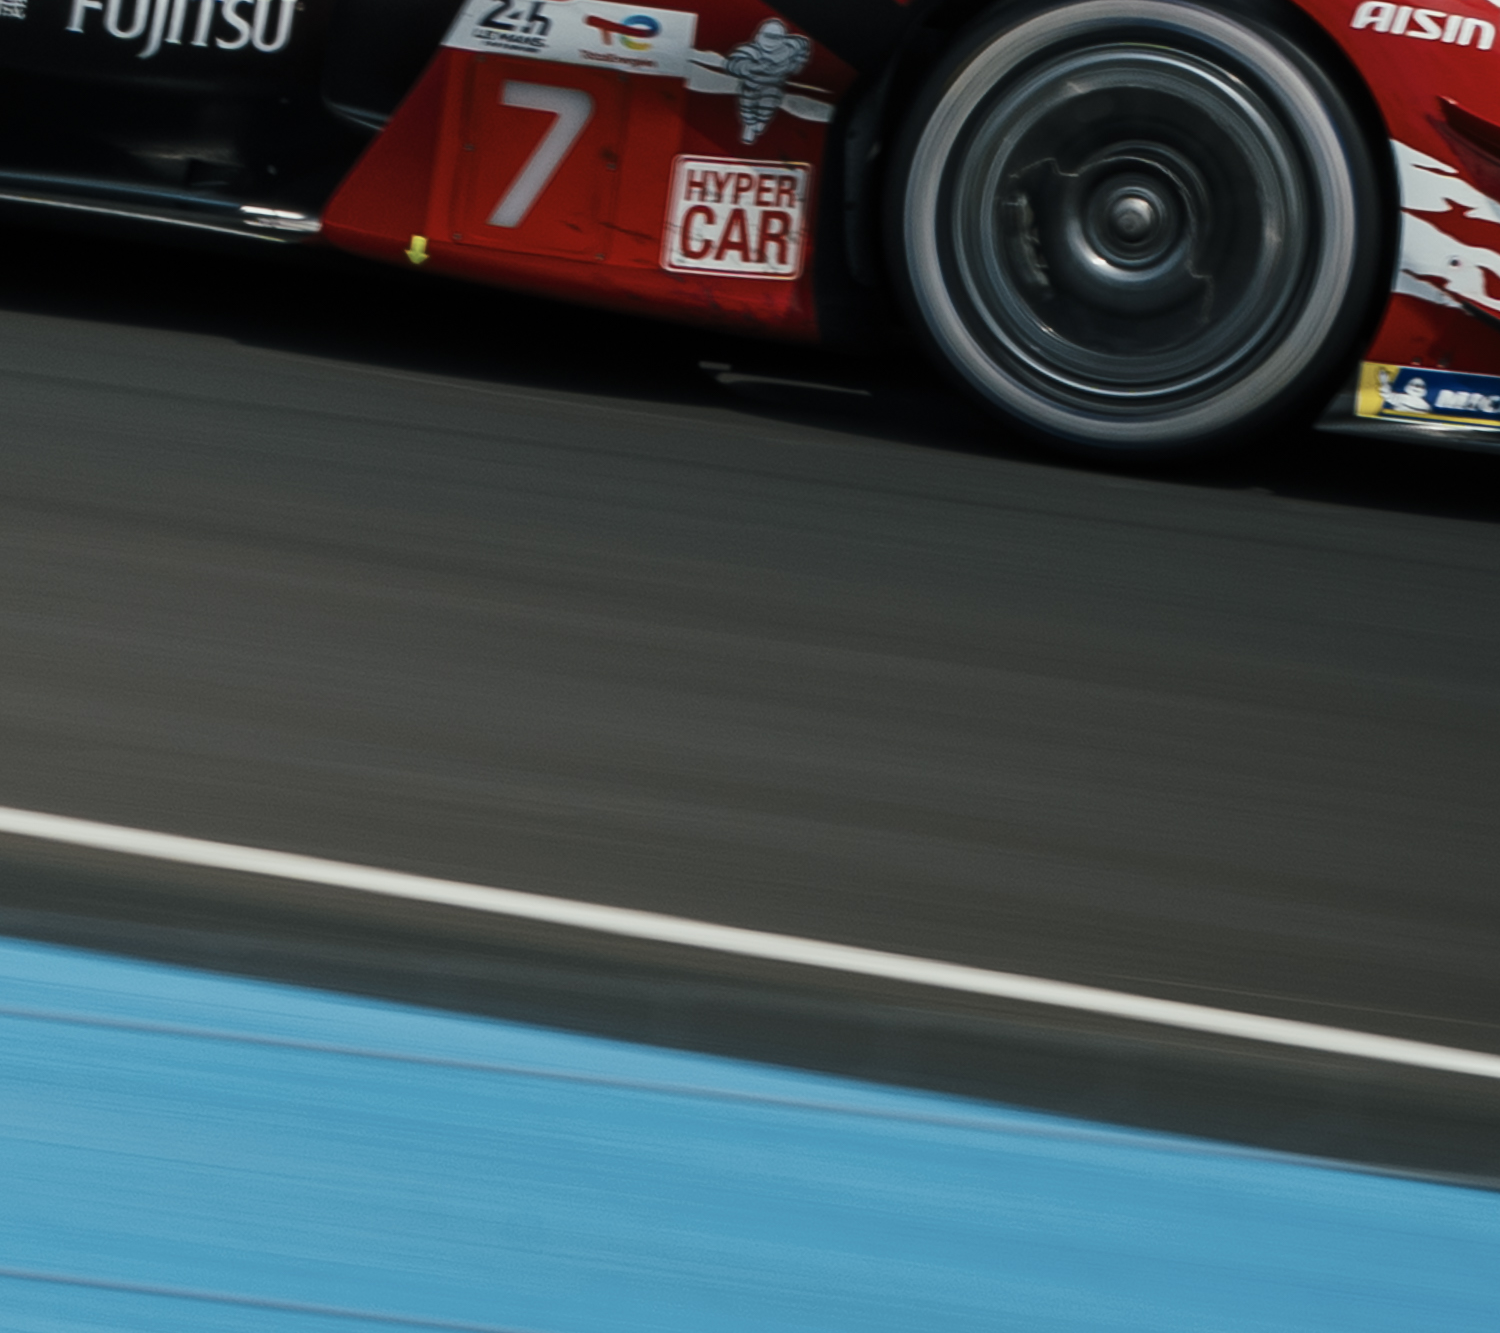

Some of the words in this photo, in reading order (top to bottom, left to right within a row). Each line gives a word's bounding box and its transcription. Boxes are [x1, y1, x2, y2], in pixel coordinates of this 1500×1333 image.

[1350, 0, 1496, 51] AISIN
[487, 79, 594, 228] 7
[684, 169, 797, 209] HYPER
[680, 204, 793, 266] CAR
